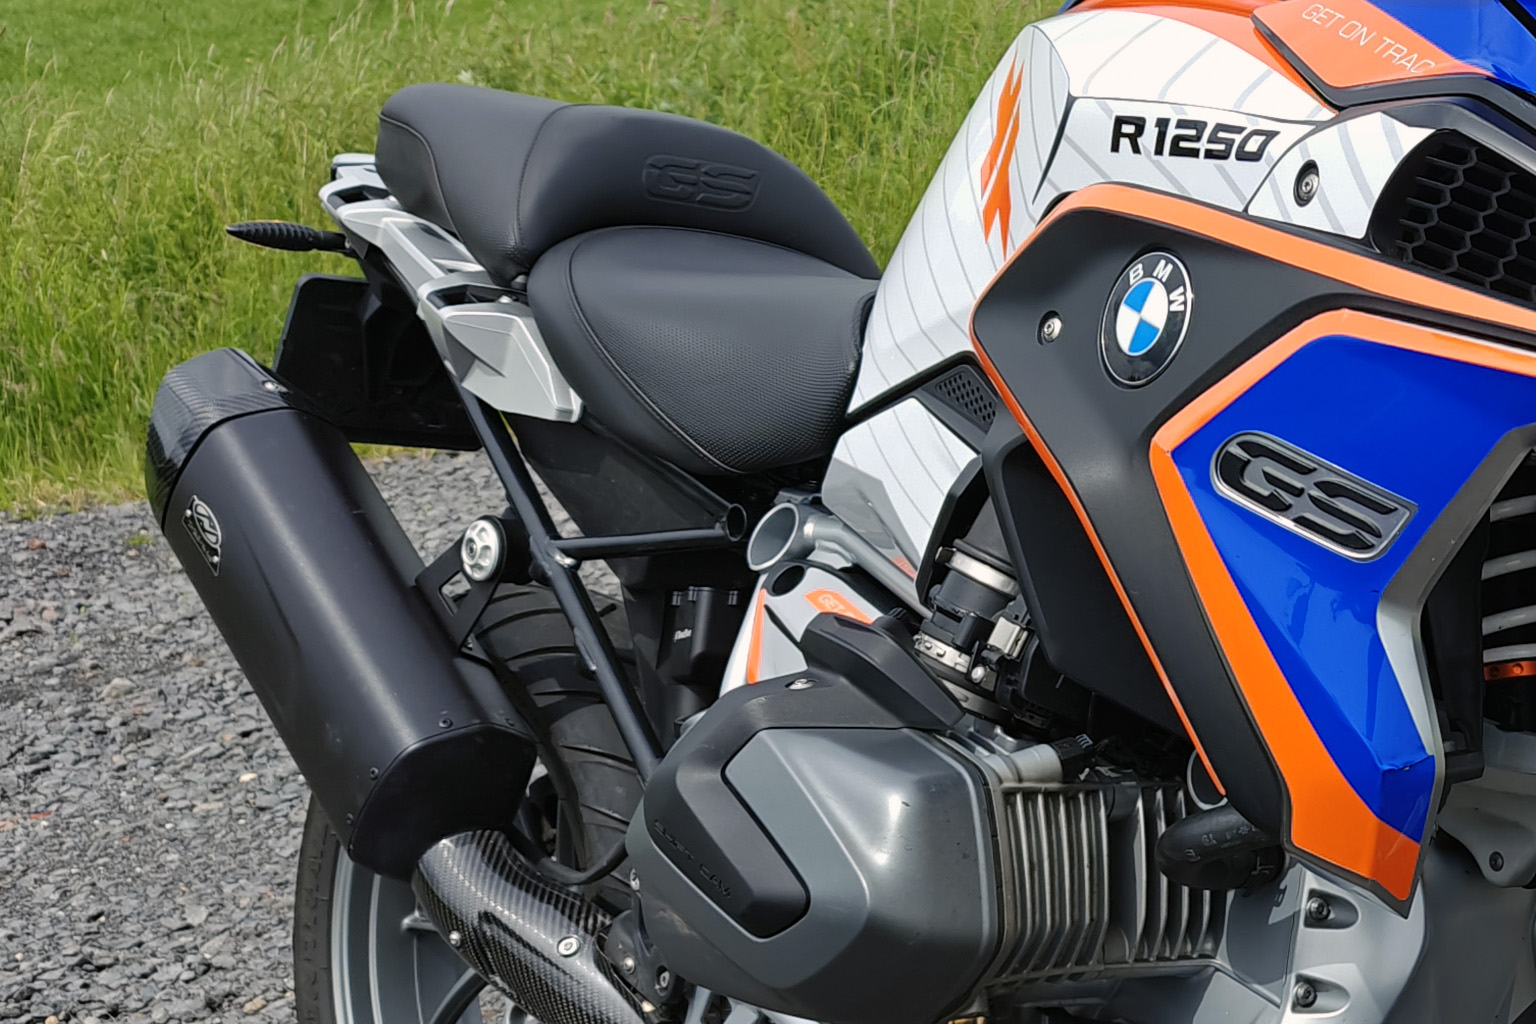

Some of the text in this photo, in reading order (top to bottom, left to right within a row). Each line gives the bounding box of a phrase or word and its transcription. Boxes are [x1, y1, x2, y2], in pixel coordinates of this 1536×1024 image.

[1301, 3, 1436, 74] GET ON TRAC
[642, 156, 757, 211] GS
[1128, 259, 1185, 312] BMW
[1218, 439, 1400, 551] GS
